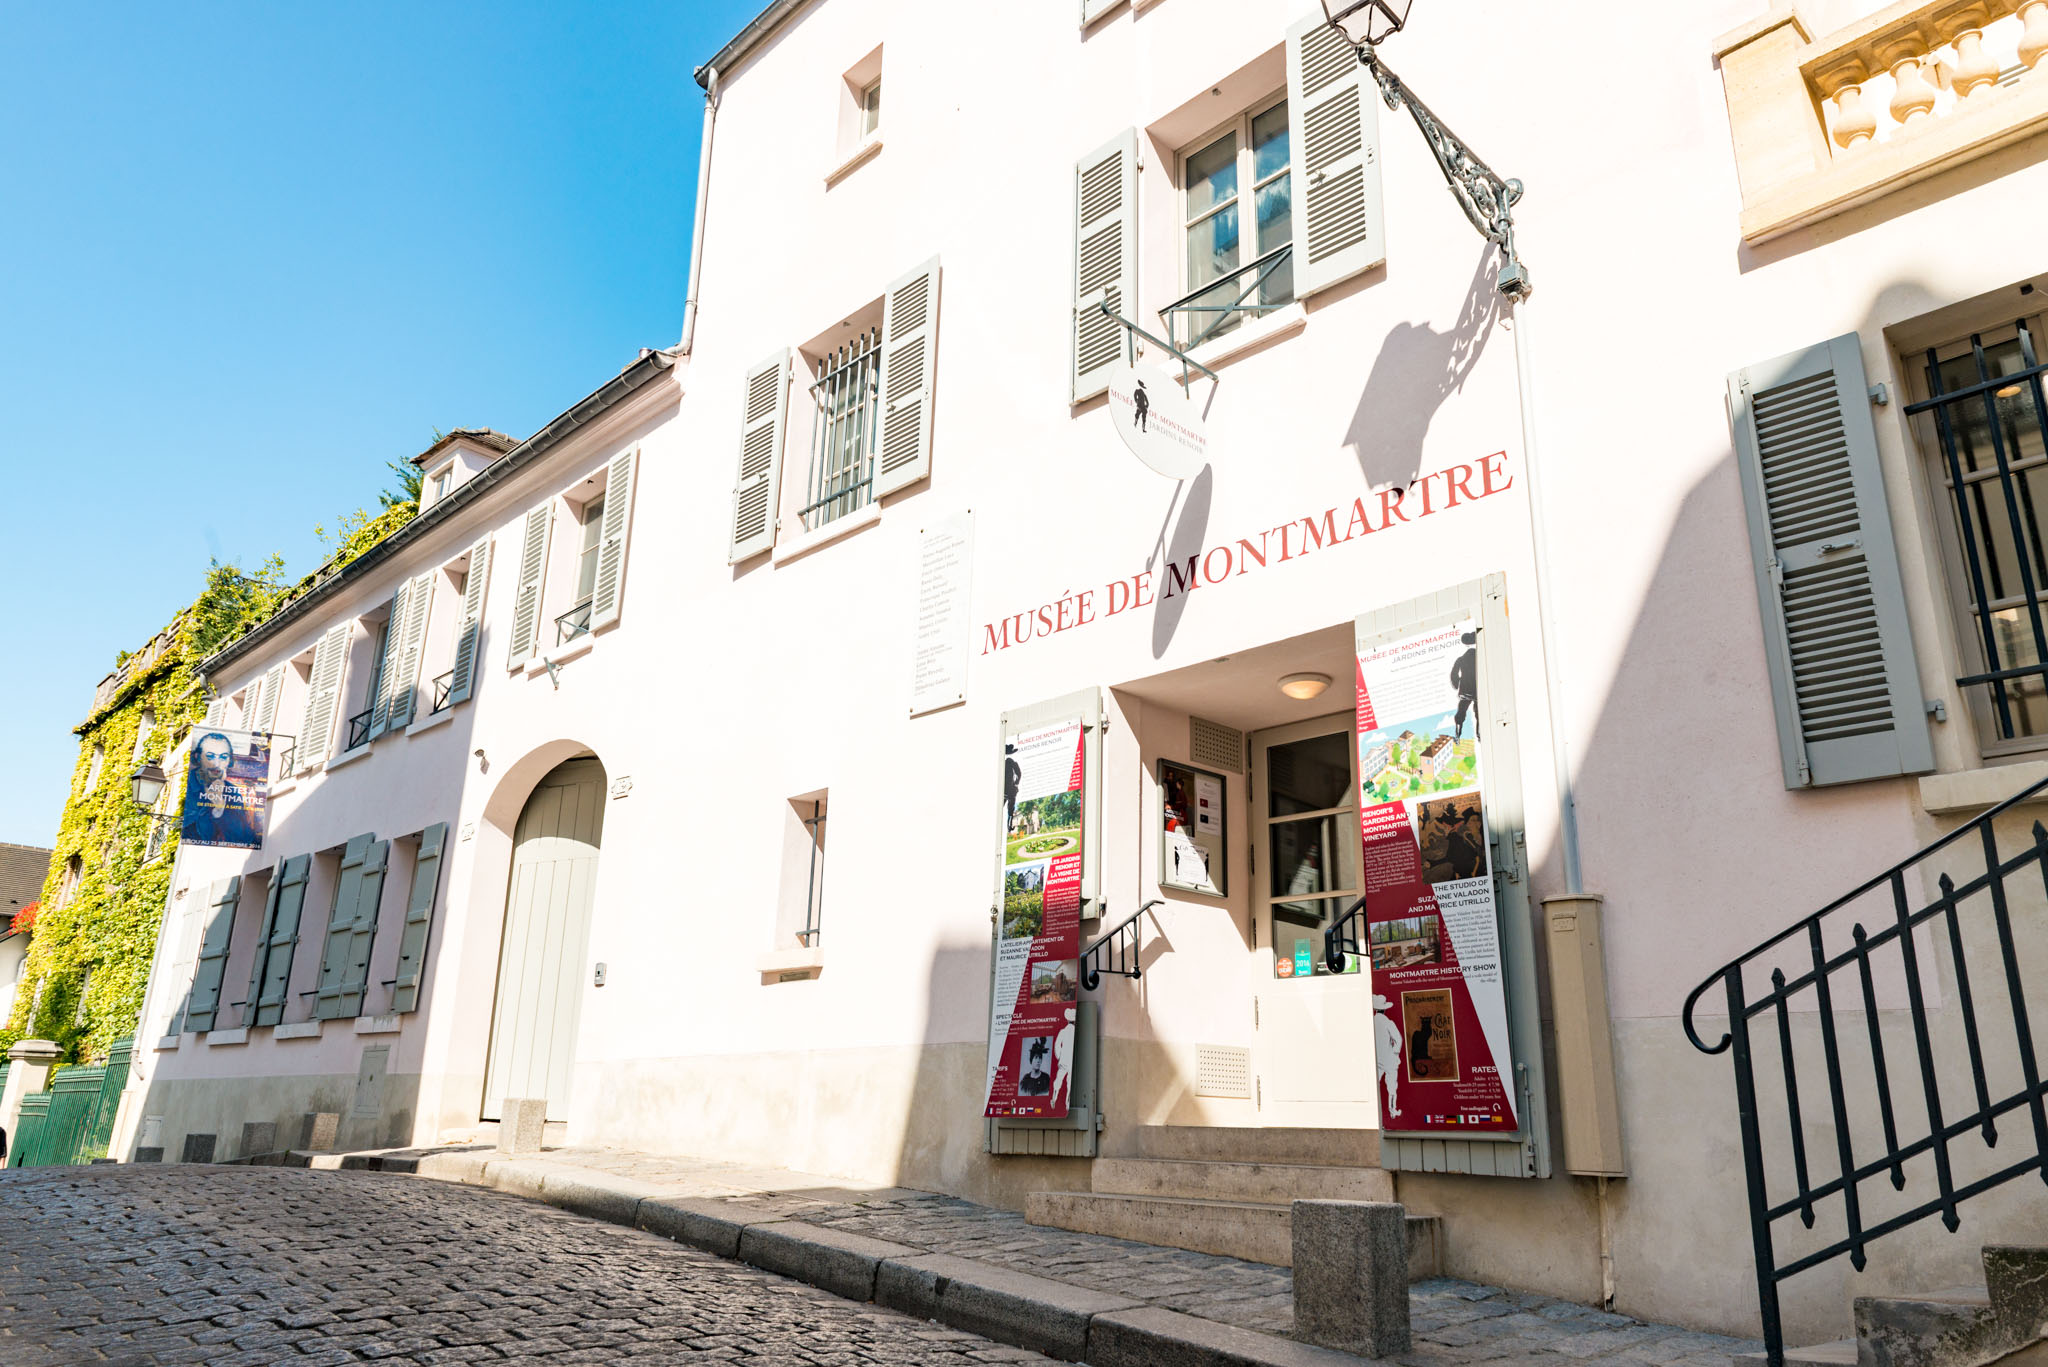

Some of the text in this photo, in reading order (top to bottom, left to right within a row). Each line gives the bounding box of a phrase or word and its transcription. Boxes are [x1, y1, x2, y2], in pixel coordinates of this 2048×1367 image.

[981, 451, 1514, 655] MUSÉE DE MONTMARTRE
[1389, 648, 1400, 656] DE
[1402, 629, 1461, 652] MONTMARTRE
[1392, 649, 1427, 664] JARDINS
[1428, 639, 1461, 653] RENOIR
[1043, 723, 1079, 738] MONTMARTRE
[199, 792, 264, 805] MONTMARTRE
[1362, 807, 1393, 818] RENOIR'S
[1363, 814, 1395, 826] GARDENS
[1363, 820, 1411, 834] MONTMARTRE
[1364, 831, 1398, 842] VINEYARD
[1450, 880, 1476, 890] STUDIO
[1418, 888, 1489, 903] SUZANNE VALADON
[1408, 905, 1424, 913] AND
[1459, 897, 1490, 907] UTRILLO
[1389, 963, 1496, 979] MONTMARTRE HISTORY SHOW
